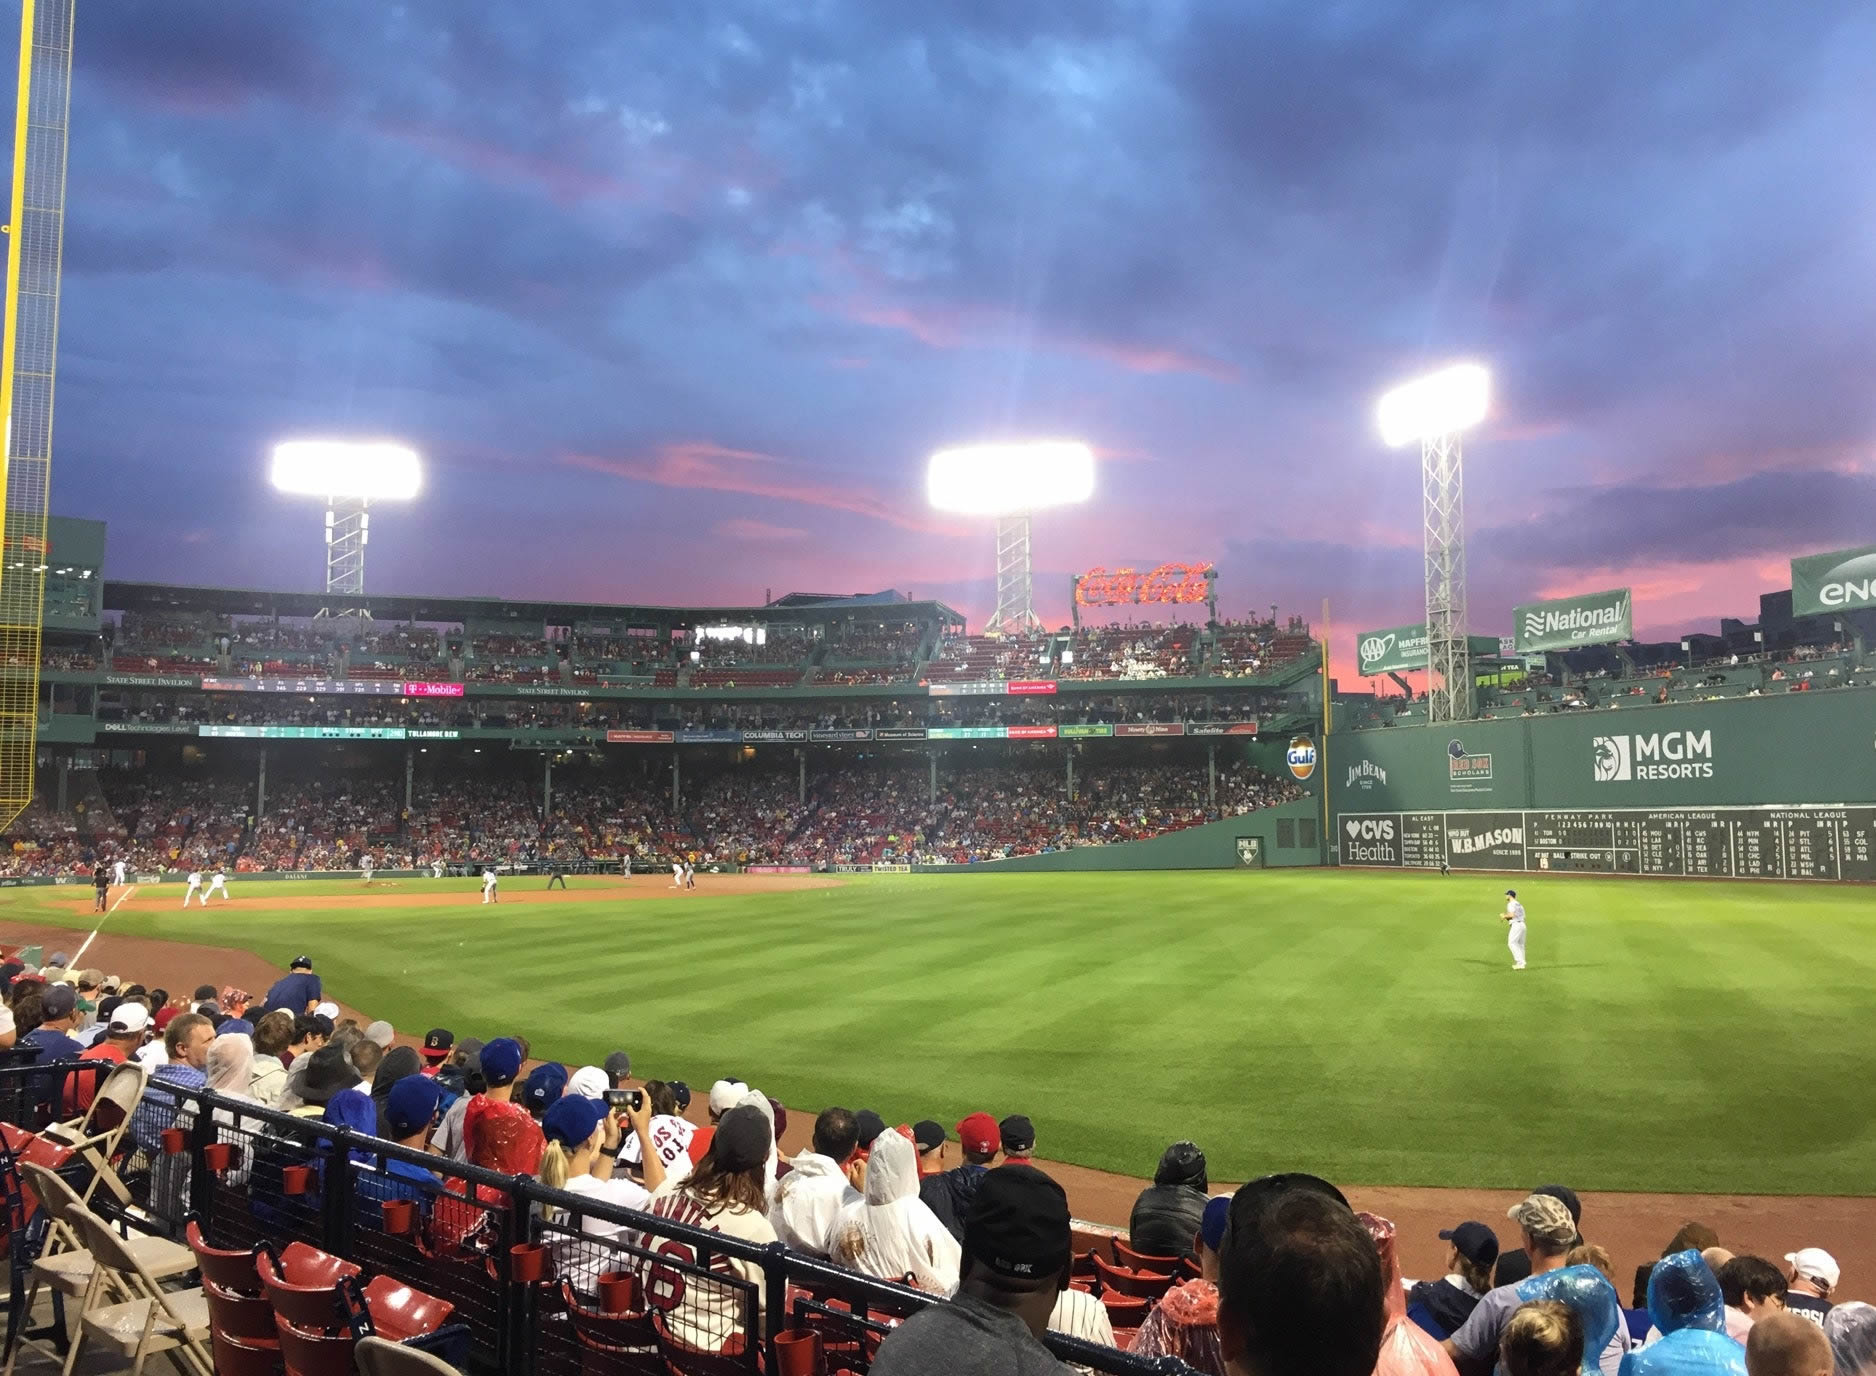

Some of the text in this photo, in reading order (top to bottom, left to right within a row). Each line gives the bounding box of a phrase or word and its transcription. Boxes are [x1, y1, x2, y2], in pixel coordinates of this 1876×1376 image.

[1545, 601, 1621, 632] National
[1571, 626, 1617, 639] Car Rental
[1401, 648, 1428, 657] INSURANC
[107, 676, 192, 686] STATE STREET PAVILION
[1635, 730, 1712, 761] MGM
[1288, 750, 1314, 765] Gulf
[1346, 760, 1386, 787] JIM BEAM
[1637, 763, 1713, 780] RESORTS
[1361, 820, 1394, 839] CVS
[1349, 842, 1395, 861] Health
[431, 1037, 438, 1046] B
